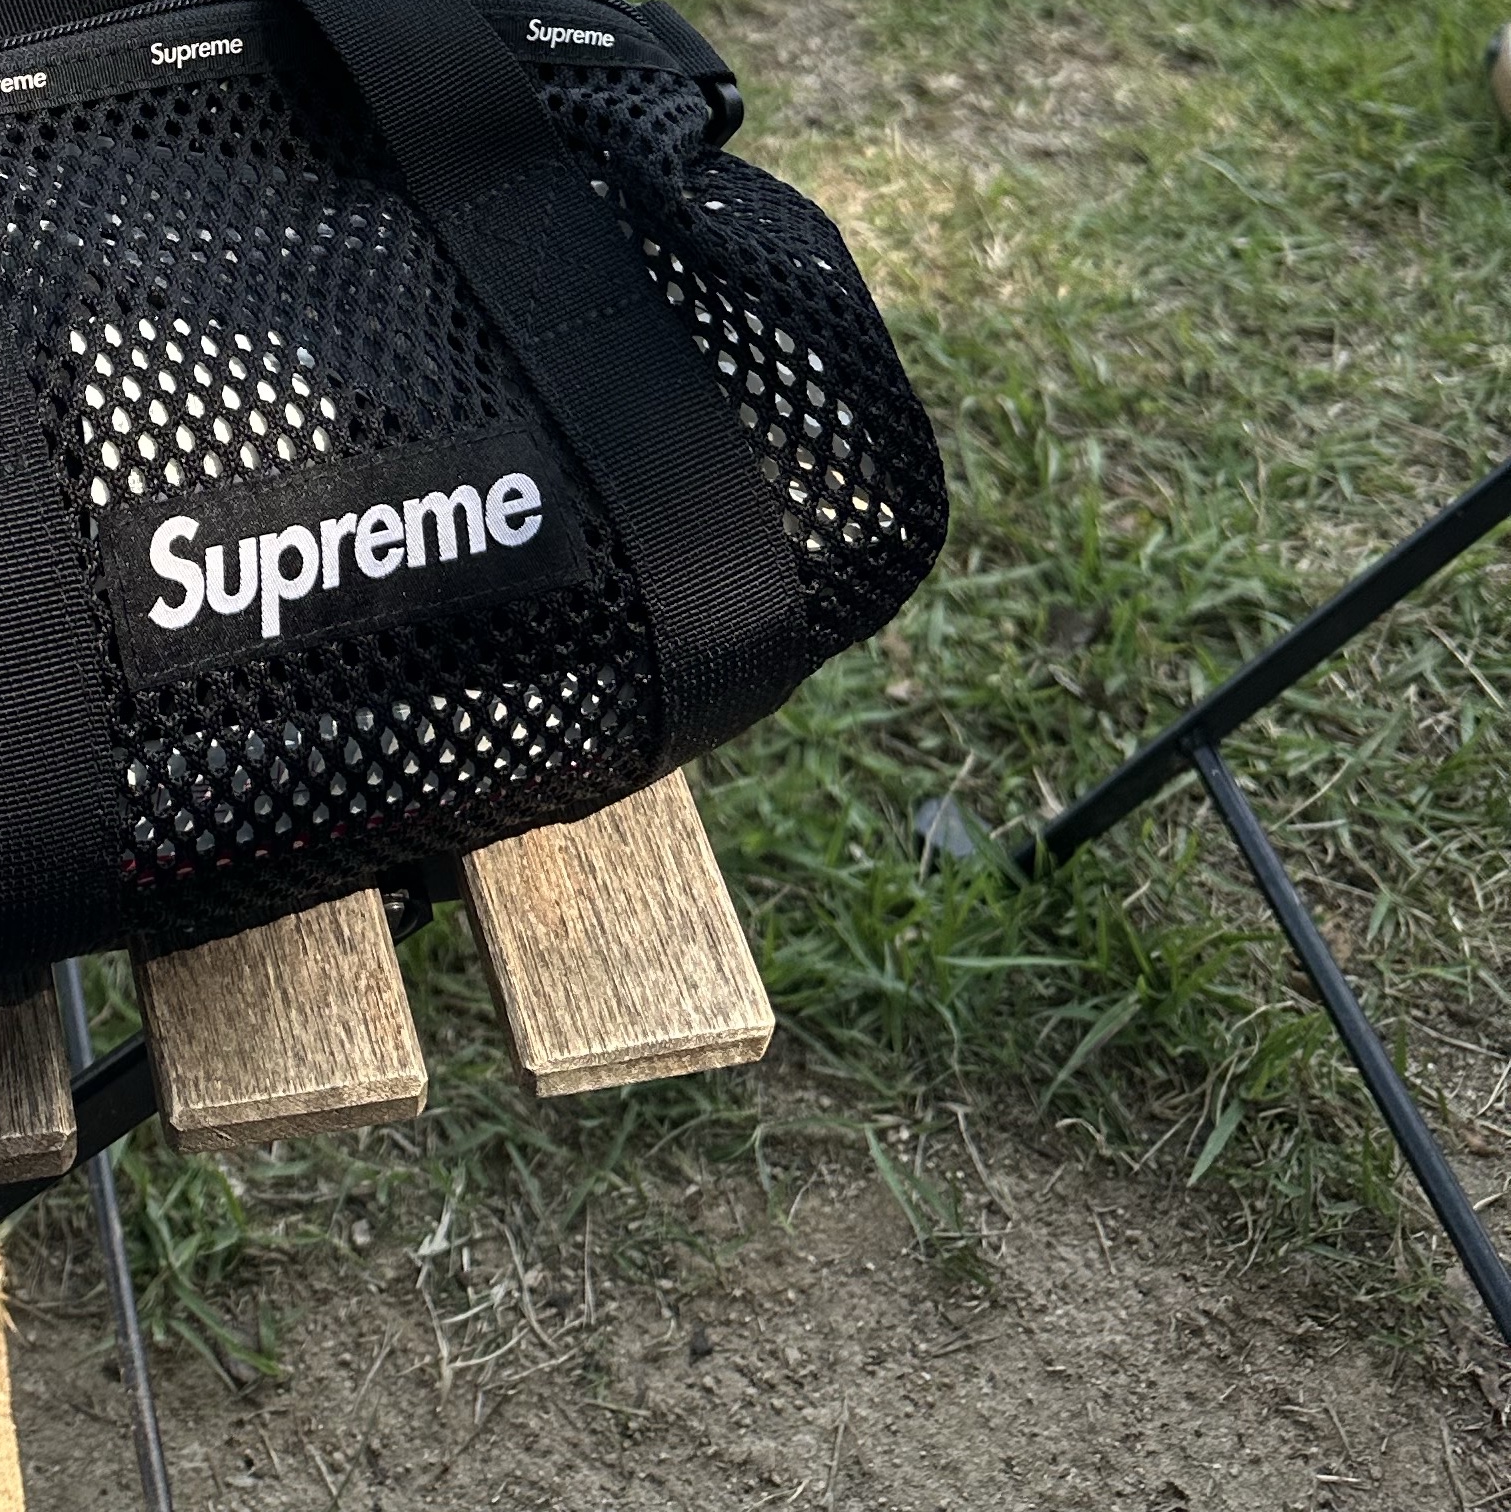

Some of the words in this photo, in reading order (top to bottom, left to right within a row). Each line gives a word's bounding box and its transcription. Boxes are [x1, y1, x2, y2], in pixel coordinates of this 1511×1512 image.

[526, 18, 615, 48] Supreme
[151, 38, 243, 68] Supreme
[148, 472, 543, 639] Supreme
